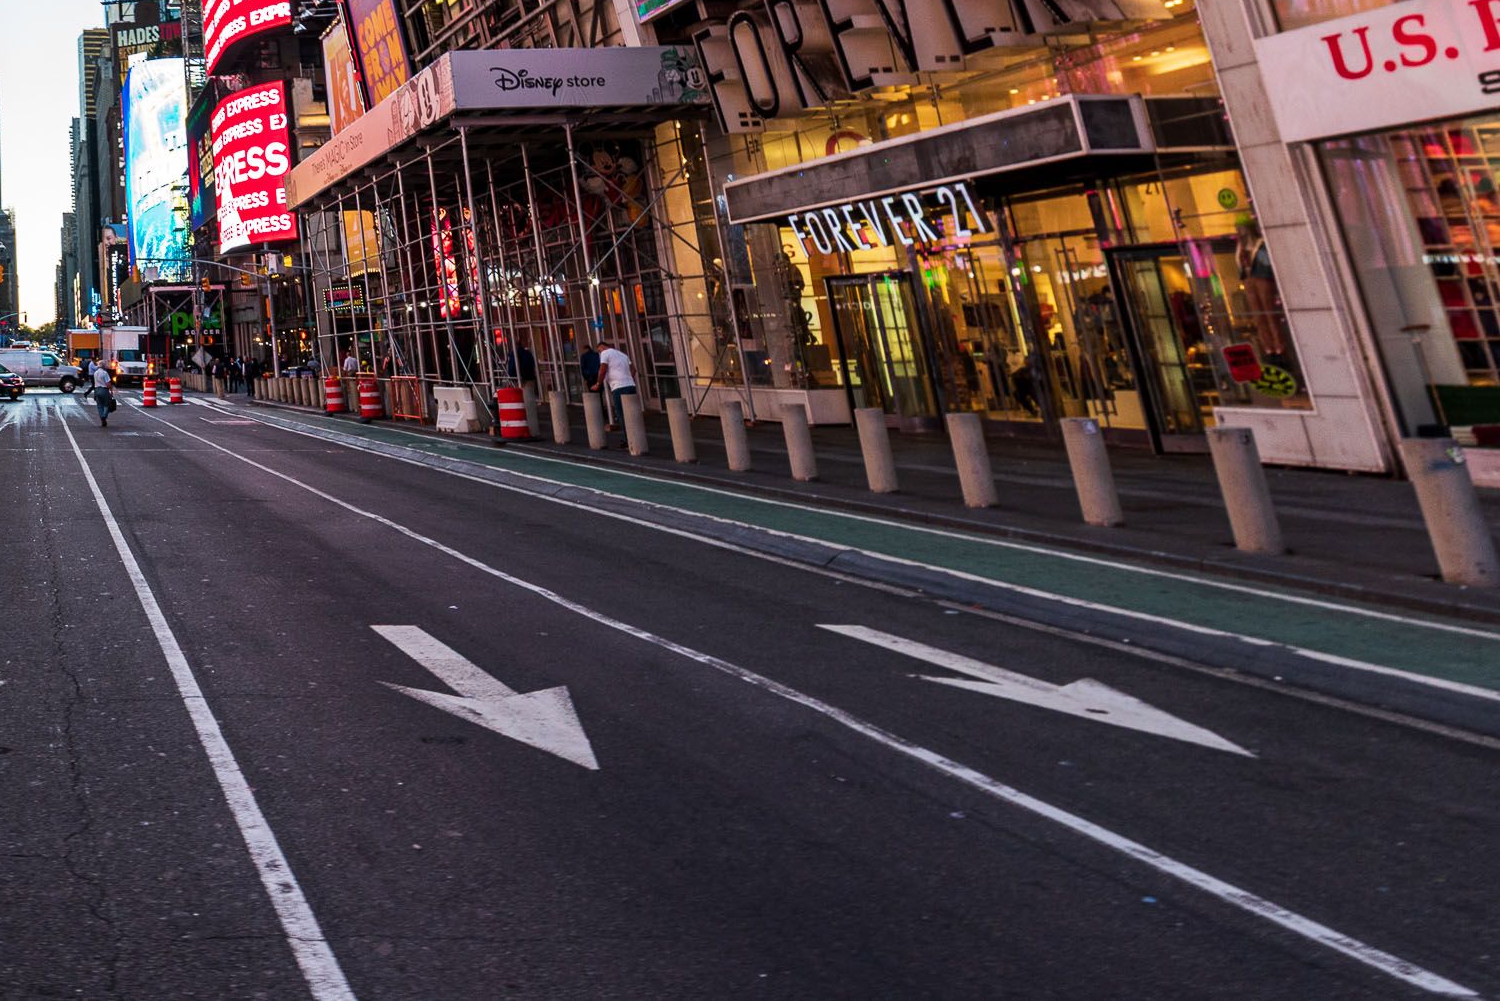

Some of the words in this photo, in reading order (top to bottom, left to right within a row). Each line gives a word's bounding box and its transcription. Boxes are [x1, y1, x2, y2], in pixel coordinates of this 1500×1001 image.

[363, 33, 404, 87] FROM
[1322, 12, 1459, 81] U.S.
[566, 74, 606, 89] store
[226, 89, 280, 117] EXPRESS
[222, 118, 263, 145] EXPRESS
[325, 139, 346, 169] MAGIC
[349, 131, 364, 151] Store
[215, 142, 289, 197] EXPRESS
[237, 214, 291, 236] EXPRESS
[788, 196, 938, 258] FOREVER
[937, 182, 993, 238] 21
